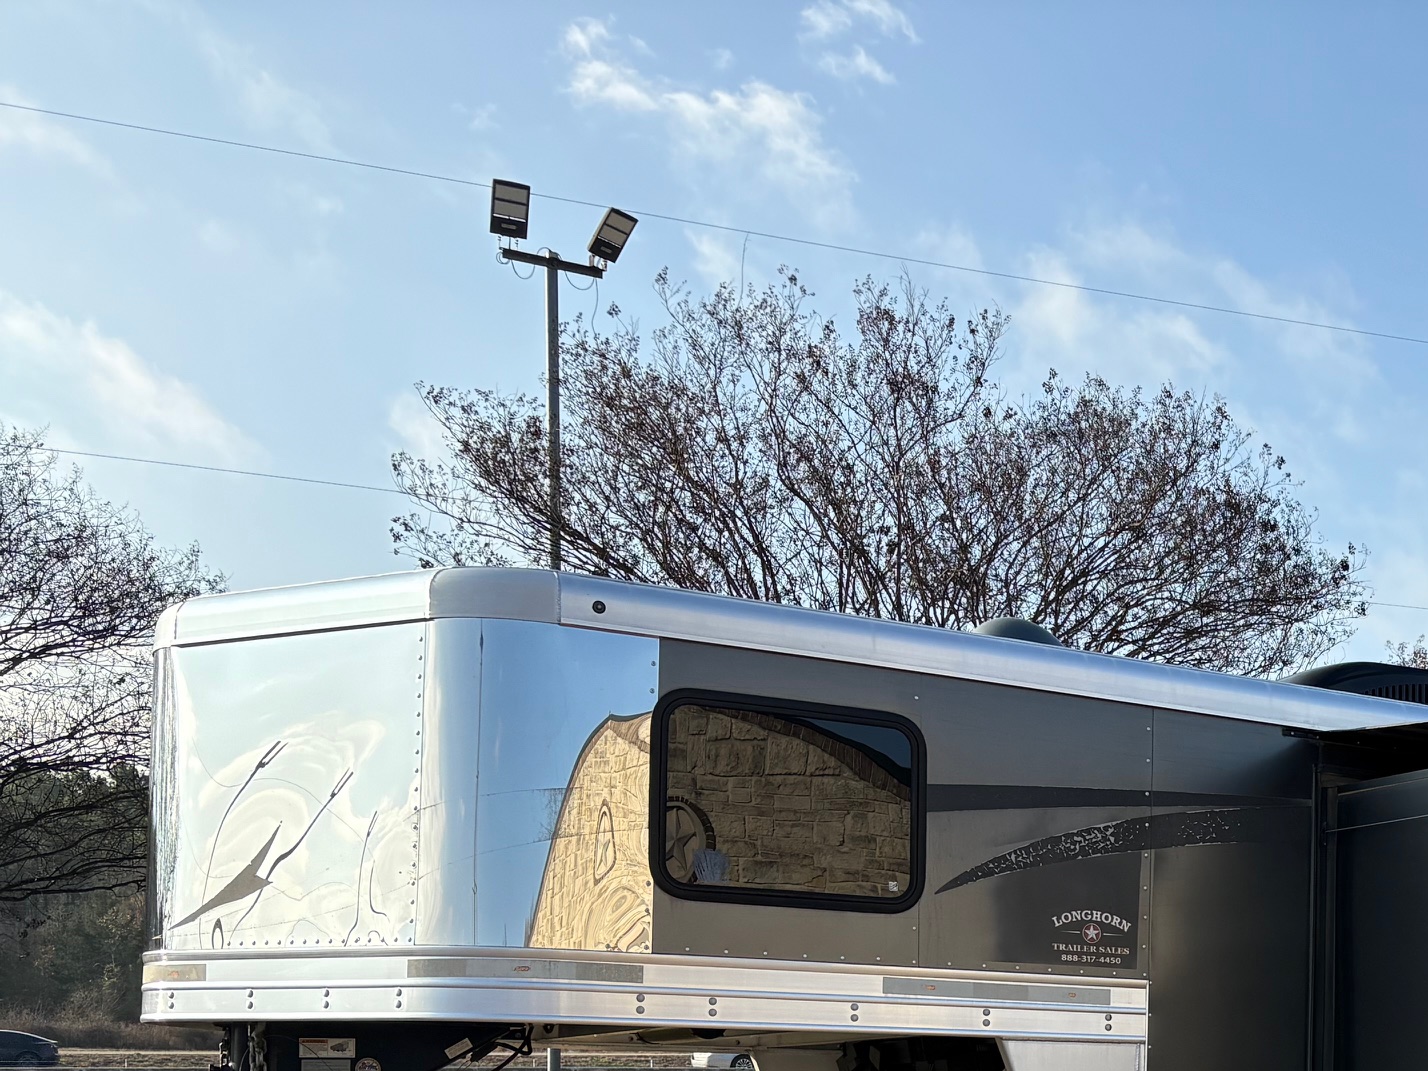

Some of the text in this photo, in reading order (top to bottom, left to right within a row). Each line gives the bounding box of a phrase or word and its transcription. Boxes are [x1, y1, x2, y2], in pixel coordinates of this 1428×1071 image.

[1051, 910, 1132, 933] LONGHORN
[1051, 943, 1130, 955] TRAILER SALES
[1061, 954, 1122, 964] 888-317-4450
